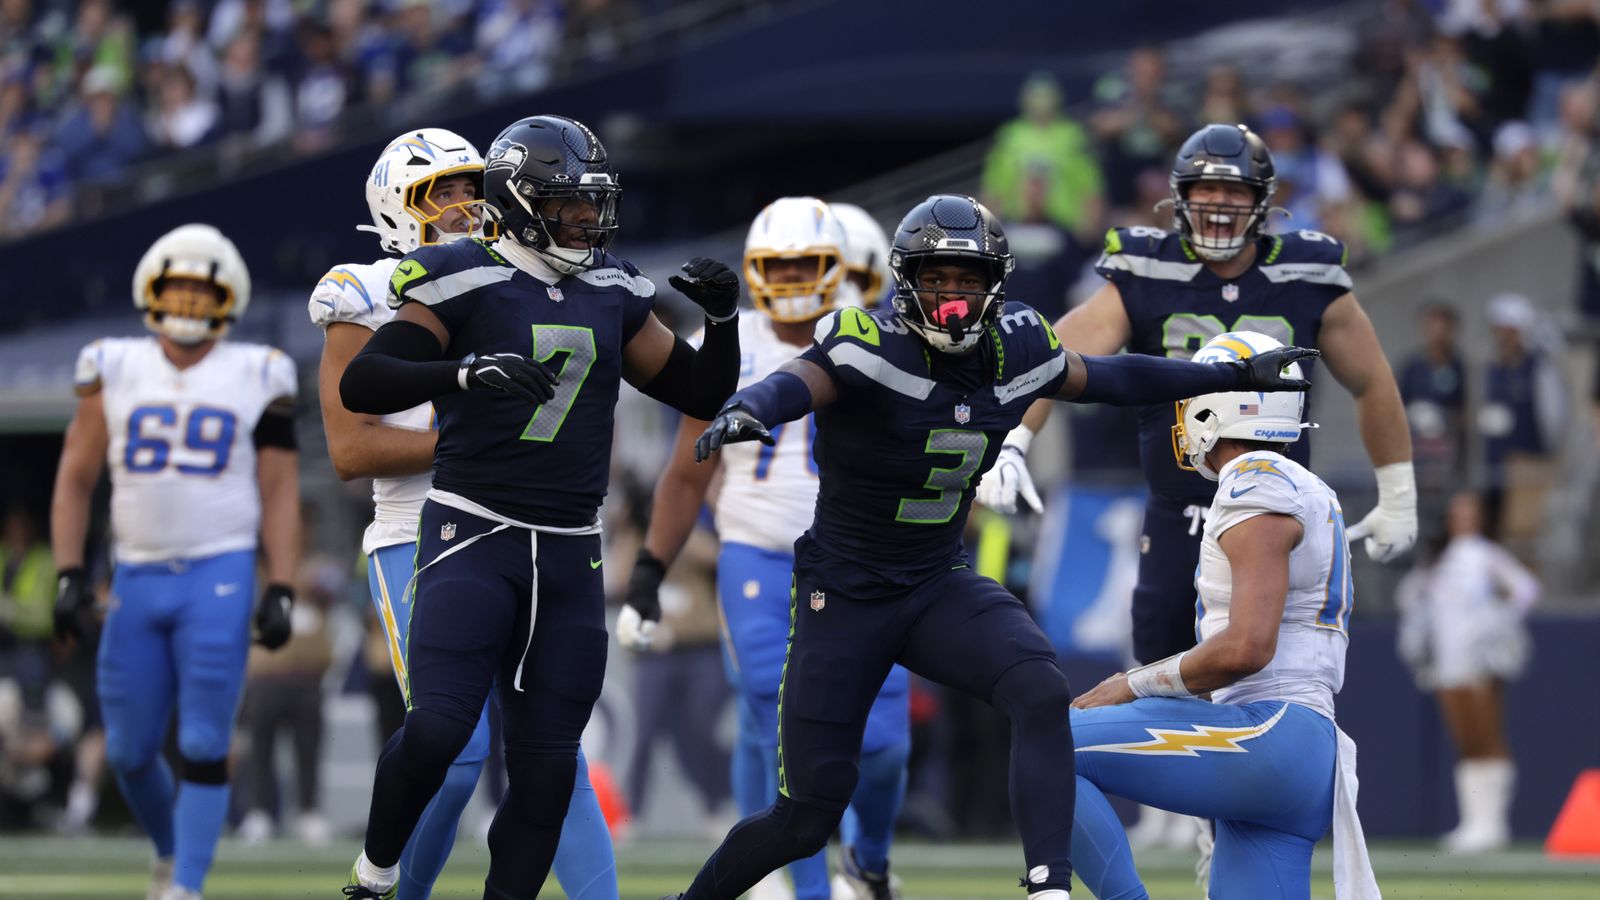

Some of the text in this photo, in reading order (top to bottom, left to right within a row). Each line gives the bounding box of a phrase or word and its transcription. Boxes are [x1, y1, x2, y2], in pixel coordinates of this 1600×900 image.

[519, 324, 597, 443] 7
[123, 404, 238, 478] 69
[895, 428, 989, 523] 3
